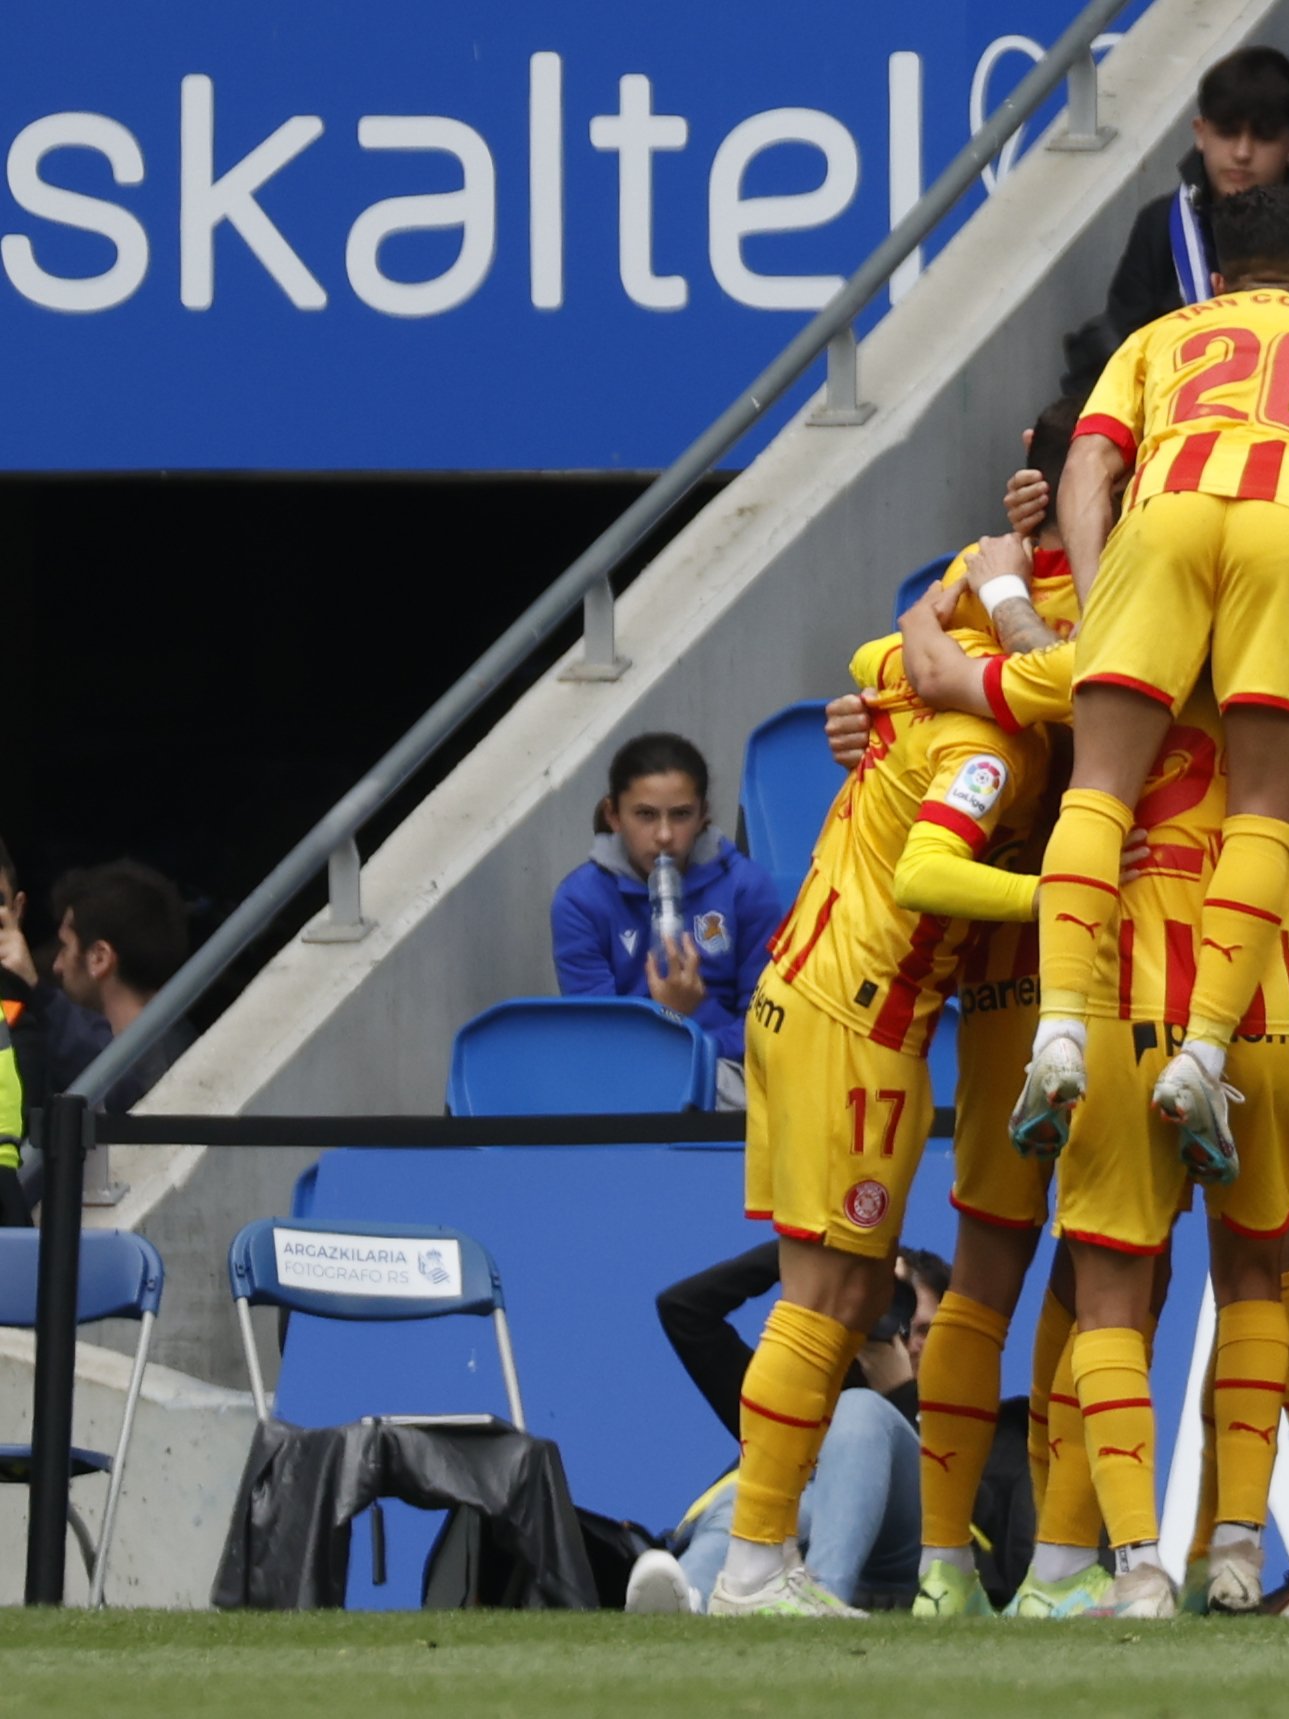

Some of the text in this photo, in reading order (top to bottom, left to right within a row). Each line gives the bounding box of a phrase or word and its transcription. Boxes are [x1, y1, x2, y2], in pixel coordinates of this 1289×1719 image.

[1, 51, 922, 316] skaltel
[1173, 298, 1239, 322] YAN
[845, 1087, 907, 1159] 17
[283, 1242, 407, 1264] ARGAZKILARIA
[284, 1260, 409, 1284] FOTOGRAFO RS
